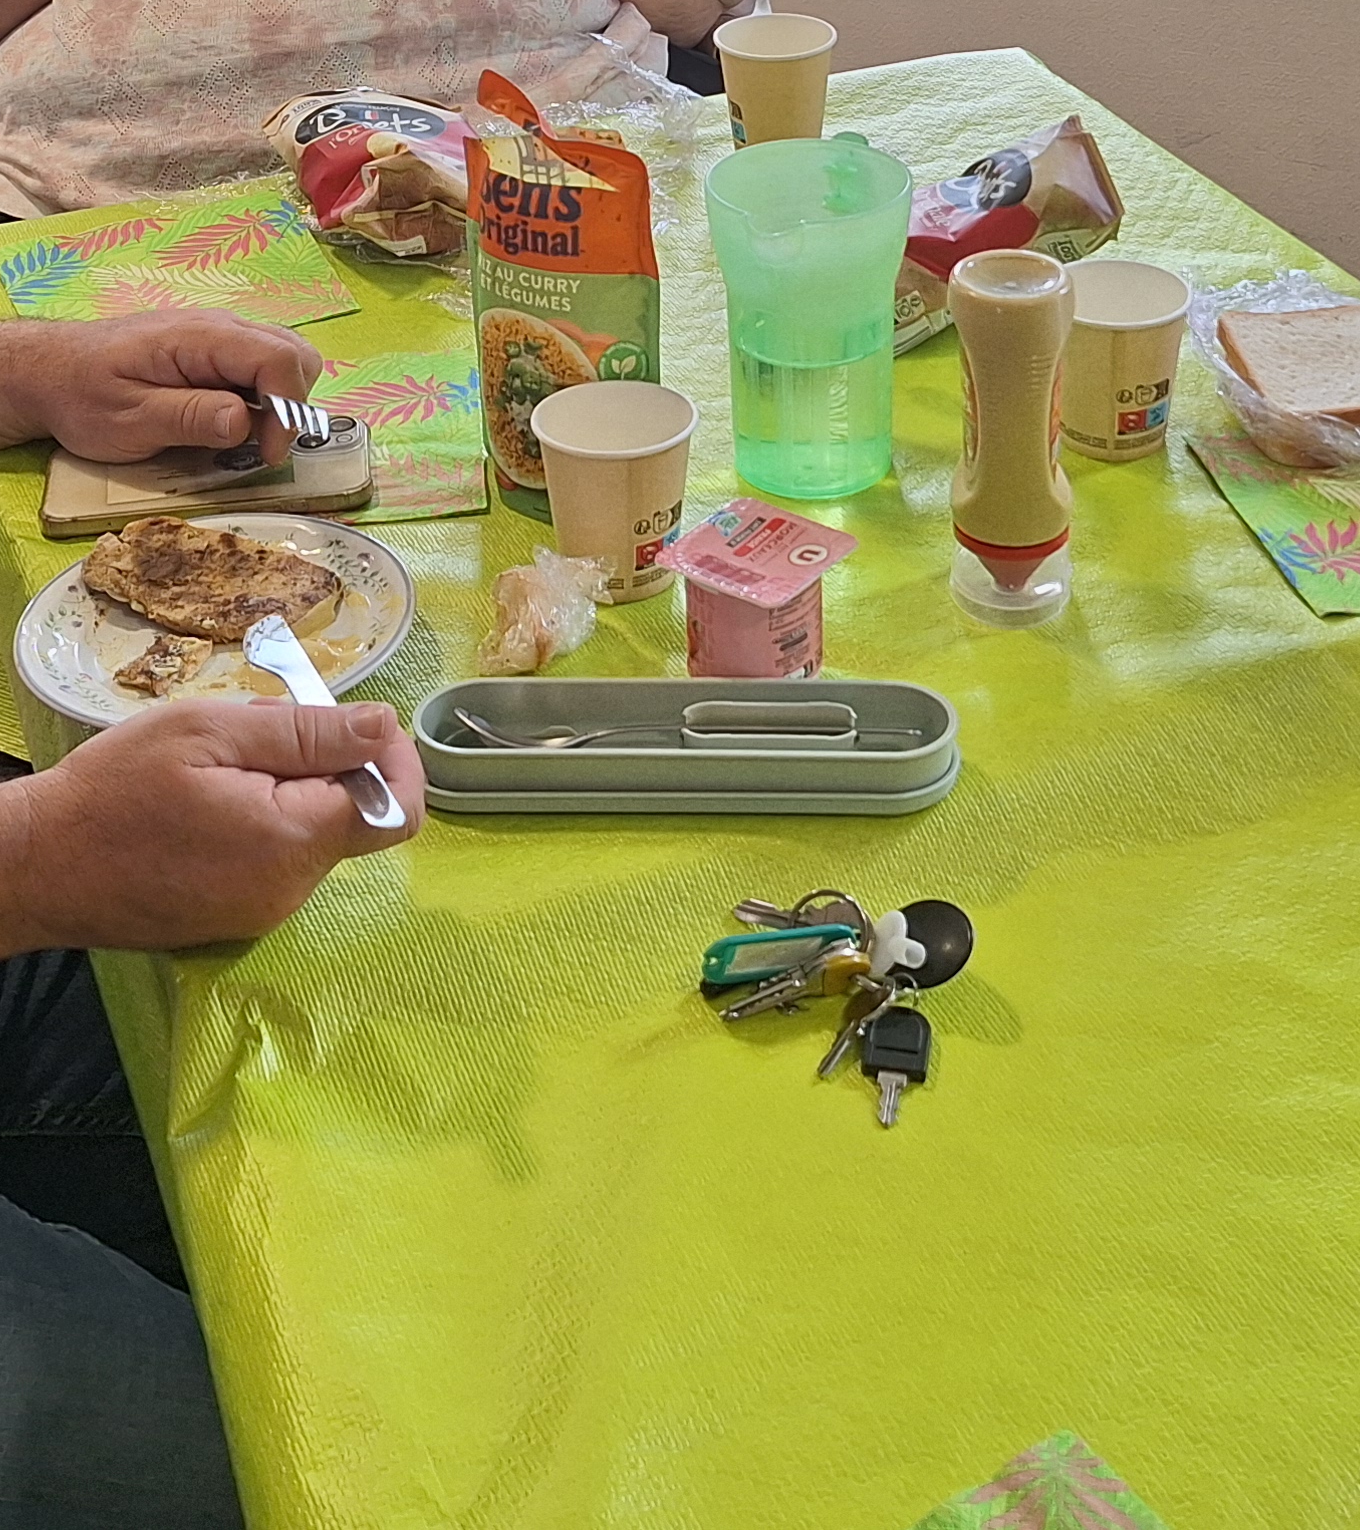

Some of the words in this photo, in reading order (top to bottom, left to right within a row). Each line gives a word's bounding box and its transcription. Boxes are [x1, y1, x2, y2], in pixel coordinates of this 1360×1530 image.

[494, 265, 515, 282] AU
[518, 271, 581, 294] CURRY
[494, 281, 572, 313] LÉGUMES
